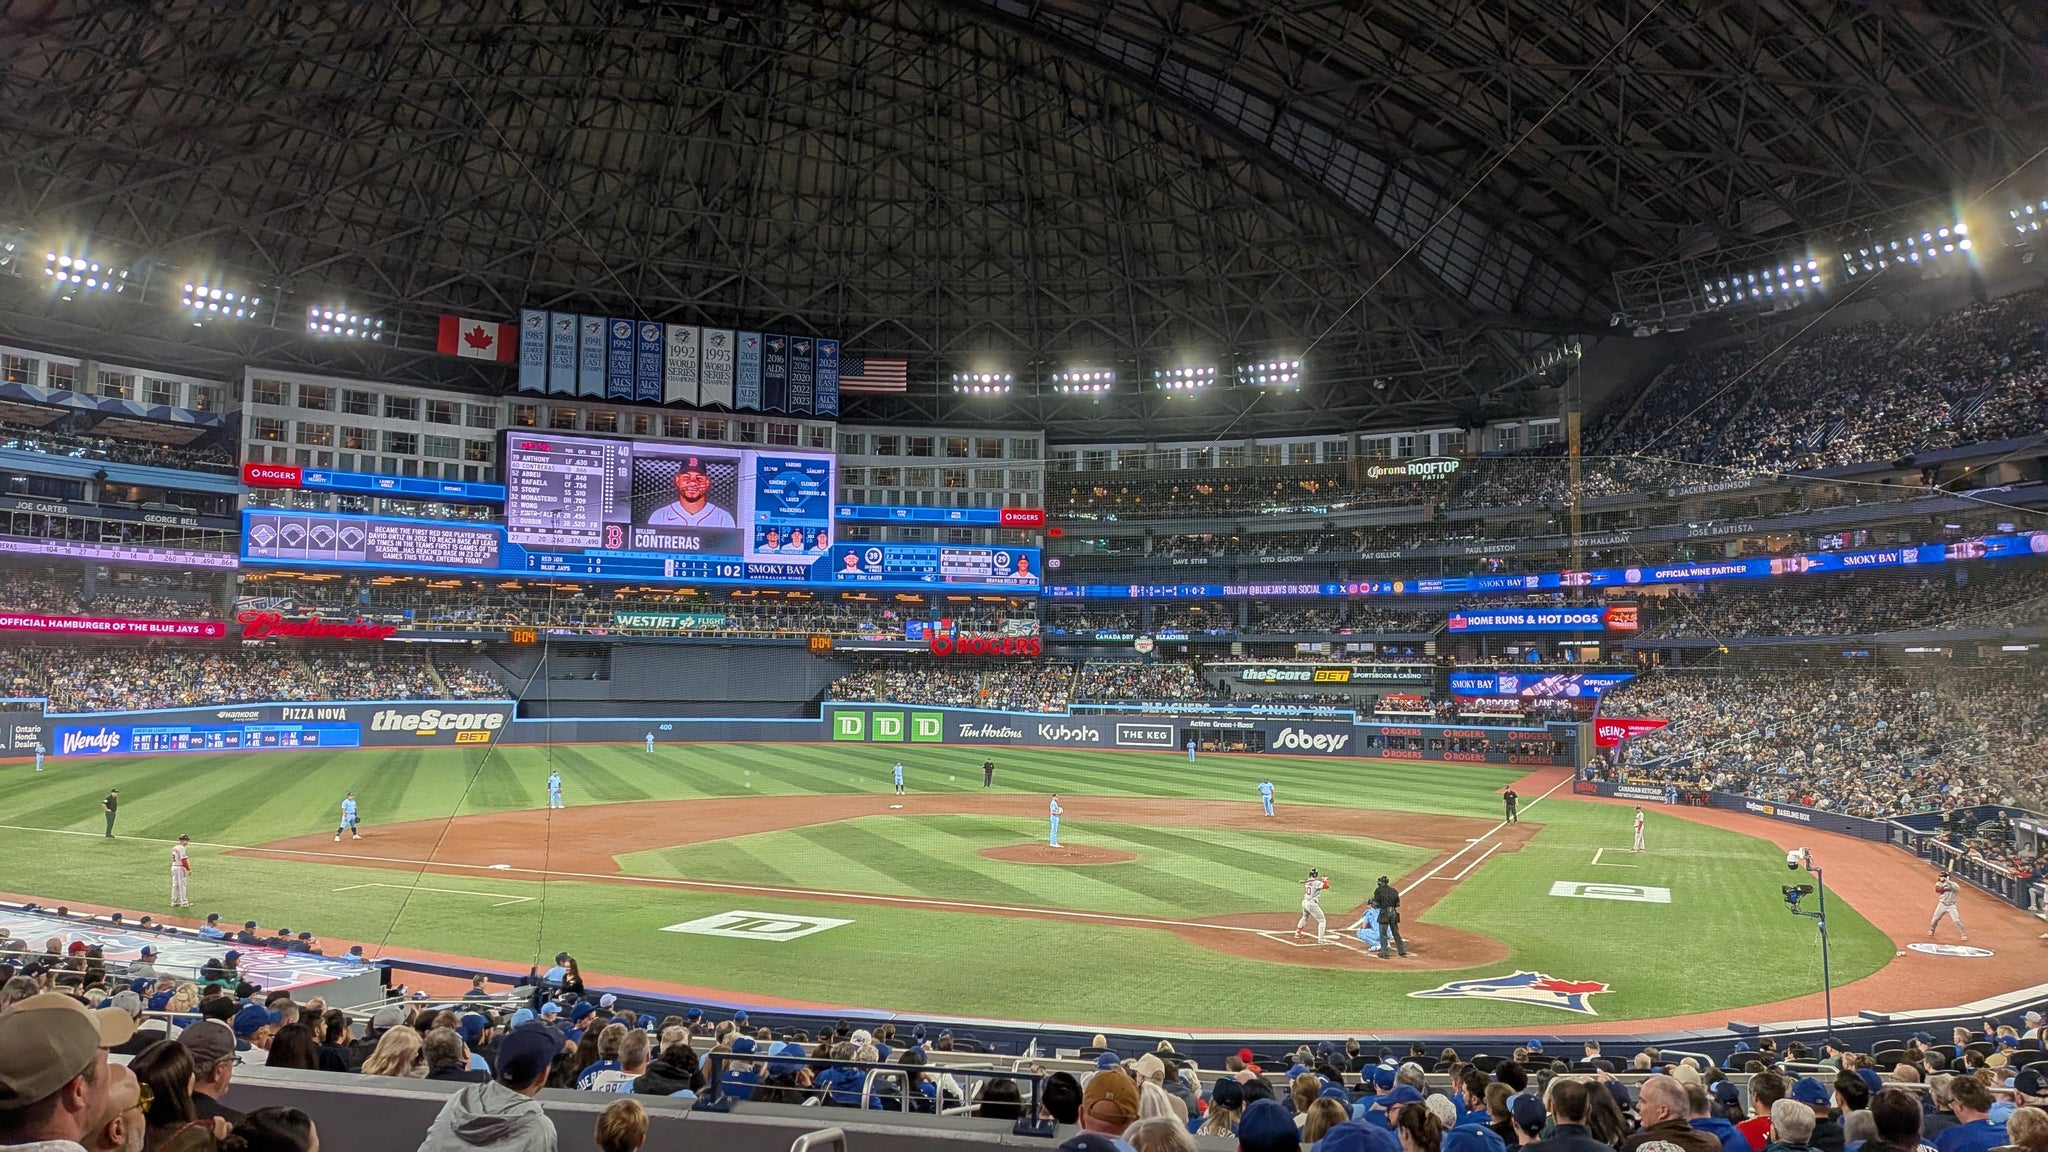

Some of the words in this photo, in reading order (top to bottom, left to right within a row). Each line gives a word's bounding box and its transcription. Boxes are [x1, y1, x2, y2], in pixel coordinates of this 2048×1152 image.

[524, 331, 544, 340] 1985
[555, 334, 573, 343] 1989
[613, 340, 631, 349] 1992
[642, 342, 659, 351] 1993
[670, 345, 695, 358] 1992
[705, 349, 731, 361] 1993
[741, 352, 758, 360] 2015
[669, 359, 695, 368] WORLD
[767, 355, 784, 363] 2016
[819, 359, 836, 367] 2025
[668, 367, 695, 377] SERIES
[704, 362, 731, 372] WORLD
[704, 371, 731, 380] SERIES
[792, 373, 810, 382] 2020
[612, 378, 631, 387] ALCS
[640, 380, 658, 389] ALCS
[792, 384, 810, 393] 2022
[792, 396, 810, 405] 2023
[818, 396, 836, 404] ALCS
[618, 446, 629, 456] 40
[618, 467, 628, 477] 1B
[1367, 465, 1406, 479] Corona
[1408, 460, 1460, 474] ROOFTOP
[261, 470, 296, 480] ROGERS
[1679, 486, 1706, 496] JACKIE
[1708, 480, 1750, 492] ROBINSON
[521, 494, 557, 502] MONASTERIO
[15, 501, 33, 510] JOE
[36, 504, 68, 514] CARTER
[144, 514, 177, 524] GEORGE
[181, 517, 198, 526] BELL
[375, 526, 398, 535] BECAME
[1712, 524, 1754, 534] BAUTISTA
[635, 535, 700, 550] CONTRERAS
[1573, 538, 1589, 547] ROY
[1590, 535, 1631, 546] HALLADAY
[416, 548, 442, 556] REACHED
[1484, 544, 1516, 553] BEESTON
[868, 552, 878, 560] 39
[1844, 555, 1876, 566] SMOKY
[1879, 553, 1898, 562] BAY
[748, 564, 784, 575] SMOKY
[787, 566, 806, 575] BAY
[1655, 569, 1689, 579] OFFICIAL
[1690, 567, 1711, 577] WINE
[1712, 565, 1747, 577] PARTNER
[1478, 580, 1506, 588] SMOKY
[1507, 578, 1523, 587] BAY
[1223, 586, 1248, 595] FOLLOW
[1249, 585, 1286, 595] @BLUEJAYS
[1288, 585, 1297, 594] ON
[1298, 584, 1321, 594] SOCIAL
[617, 615, 679, 628] WESTJET
[698, 618, 725, 626] FLIGHT
[1468, 616, 1494, 625] HOME
[1495, 616, 1524, 625] RUNS
[1528, 615, 1535, 624] &
[1538, 615, 1562, 624] HOT
[1564, 614, 1598, 624] DOGS
[0, 617, 47, 627] OFFICIAL
[48, 620, 111, 630] HAMBURGER
[113, 622, 126, 630] OF
[128, 623, 147, 631] THE
[149, 624, 175, 632] BLUE
[176, 625, 199, 634] JAYS
[237, 610, 397, 640] Budweiser
[513, 631, 536, 643] 0:04
[956, 637, 1041, 655] ROGERS
[1242, 669, 1311, 681] theScore
[1316, 672, 1349, 681] BET
[1452, 679, 1476, 689] SMOKY
[1477, 680, 1494, 689] BAY
[283, 708, 314, 720] PIZZA
[318, 708, 346, 720] NOVA
[371, 710, 504, 732] theScore
[837, 716, 862, 735] TD
[875, 717, 900, 735] TD
[914, 718, 940, 736] TD
[959, 723, 979, 738] Tim
[981, 723, 1023, 739] Hortons
[1390, 727, 1422, 736] ROGERS
[1599, 726, 1625, 738] HEINZ
[458, 732, 488, 742] BET
[1038, 724, 1099, 741] Kubota
[1123, 731, 1143, 739] THE
[1146, 731, 1167, 740] KEG
[1453, 730, 1486, 738] ROGERS
[1518, 732, 1552, 740] ROGERS
[63, 727, 121, 754] Wendy's
[1272, 727, 1349, 753] Sobeys
[1390, 750, 1422, 759] ROGERS
[1453, 752, 1486, 761] ROGERS
[1519, 755, 1552, 764] ROGERS
[1777, 809, 1800, 819] BASELINE
